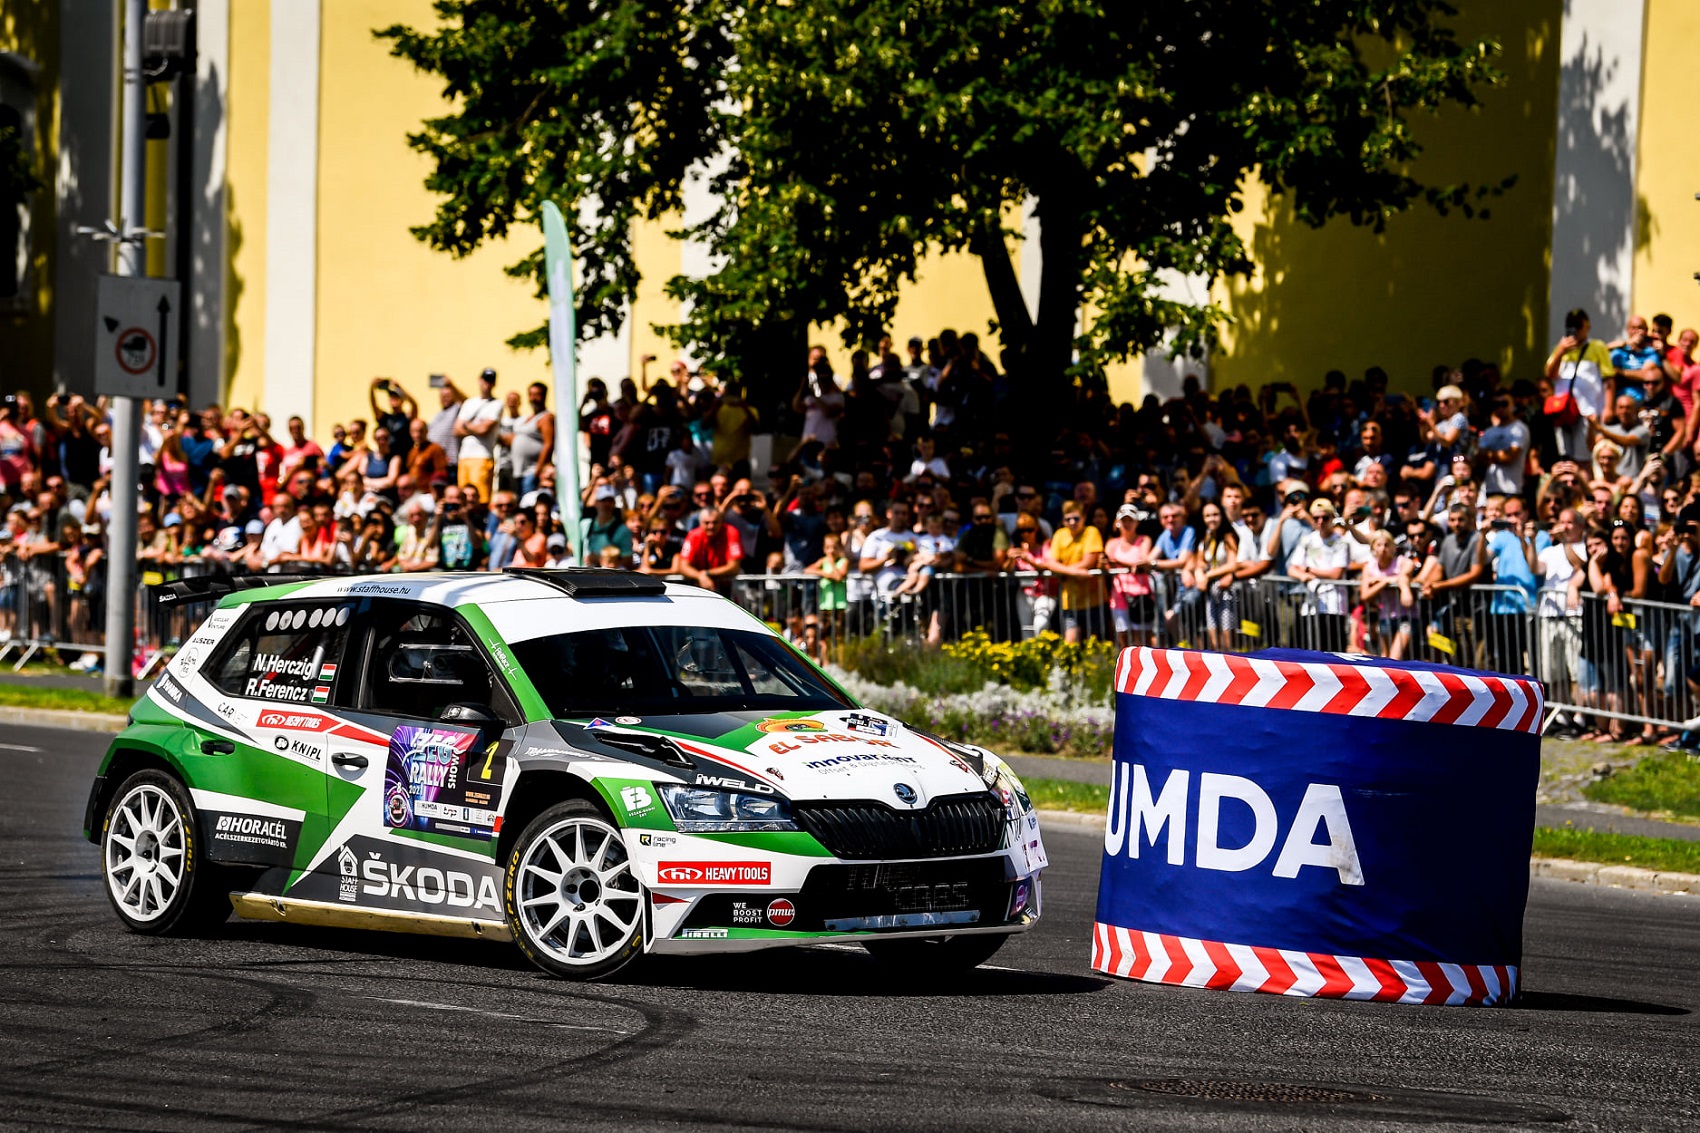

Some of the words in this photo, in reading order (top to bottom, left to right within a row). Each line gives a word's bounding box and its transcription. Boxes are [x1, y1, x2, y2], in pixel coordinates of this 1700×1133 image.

[253, 653, 313, 681] N.Herczig
[245, 678, 307, 701] R.Ferencz
[291, 740, 322, 760] KNIPL
[769, 741, 802, 755] EL
[481, 741, 500, 780] 2
[409, 762, 449, 788] RALLY
[447, 753, 460, 790] SHOW
[695, 774, 775, 794] iWELD
[230, 816, 287, 840] HORACÉL
[653, 835, 676, 845] racing
[362, 851, 502, 913] ŠKODA
[705, 867, 737, 880] HEAVY
[738, 867, 768, 880] TOOLS
[733, 909, 762, 917] BOOST
[733, 916, 762, 924] PROFIT
[681, 928, 729, 939] PIRELLI
